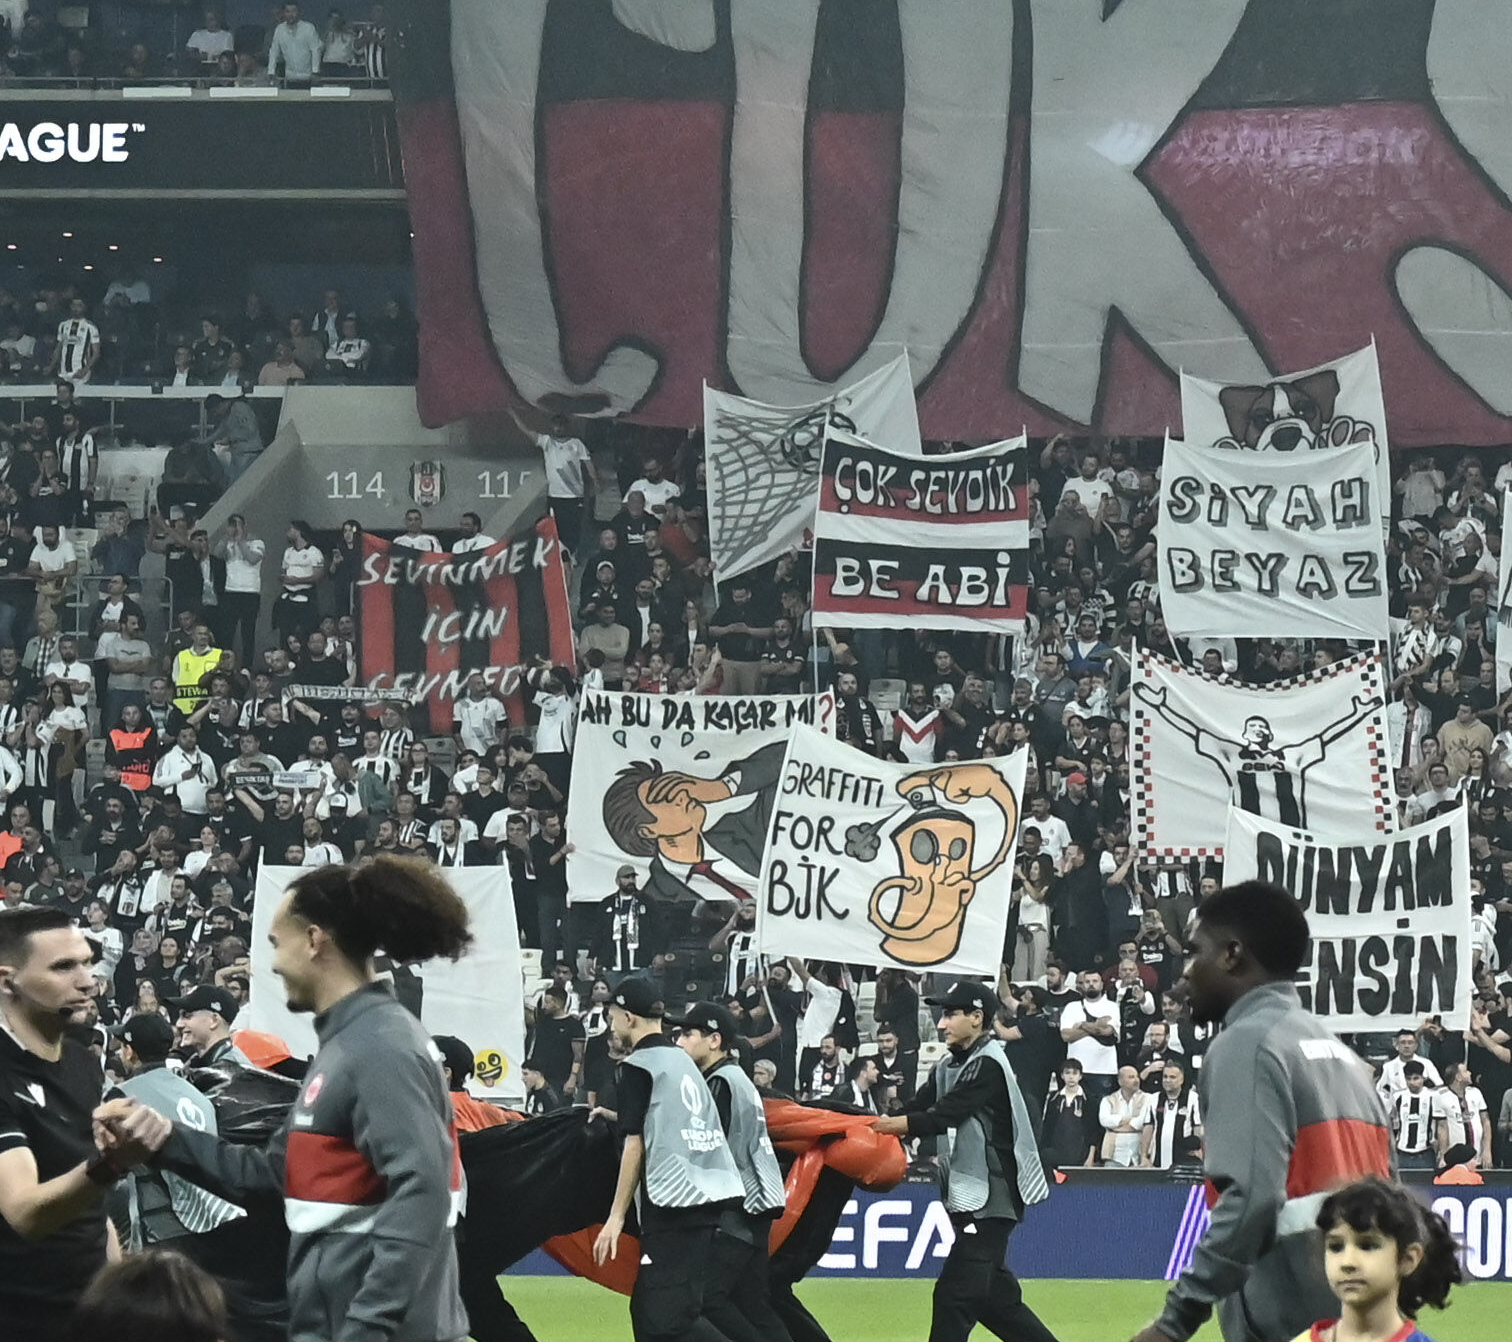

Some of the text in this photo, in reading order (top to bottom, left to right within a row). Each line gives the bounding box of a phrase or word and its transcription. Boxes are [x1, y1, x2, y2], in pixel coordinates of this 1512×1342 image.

[326, 471, 386, 499] 114
[834, 456, 1018, 514] ÇOK SEVDİK
[1168, 476, 1372, 531] SİYAH
[830, 551, 1012, 607] BE ABİ
[1166, 547, 1382, 598] BEYAZ
[420, 601, 508, 654] İÇİN
[579, 697, 612, 724] AH
[621, 699, 652, 728] BU
[661, 699, 695, 731] DA
[703, 699, 777, 735] KAÇAR
[772, 811, 844, 856] FOR
[767, 855, 850, 921] BJK
[1256, 825, 1453, 915] DÜNYAM
